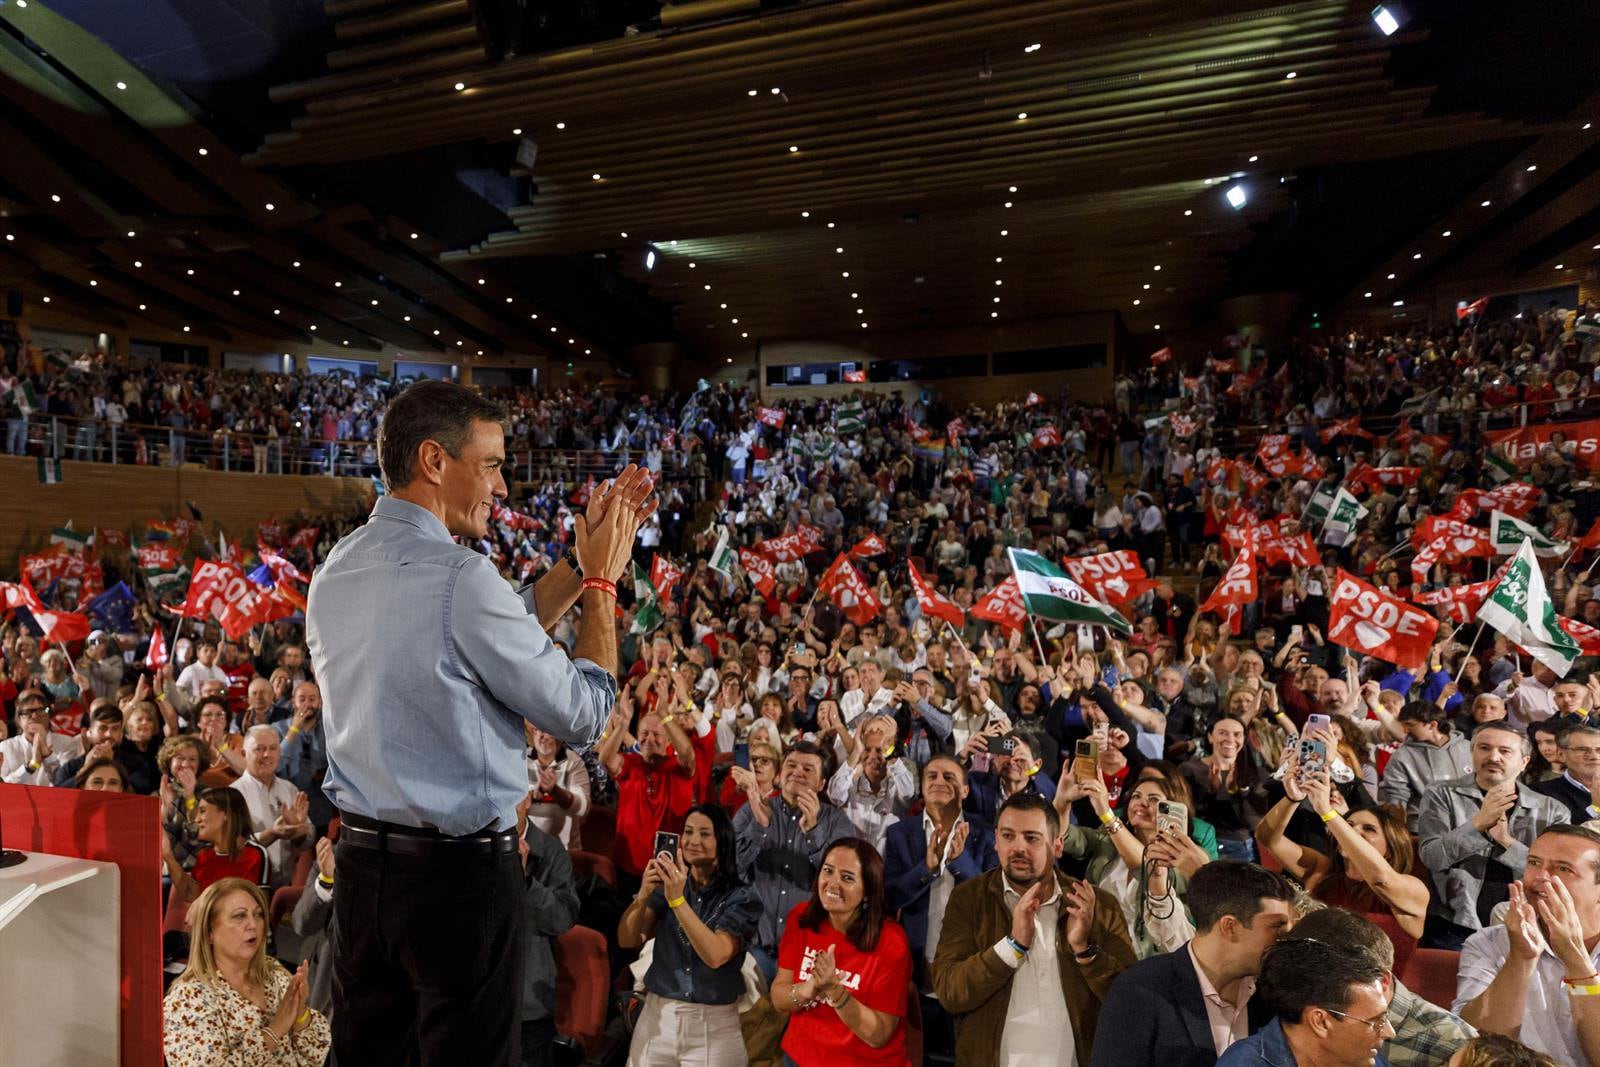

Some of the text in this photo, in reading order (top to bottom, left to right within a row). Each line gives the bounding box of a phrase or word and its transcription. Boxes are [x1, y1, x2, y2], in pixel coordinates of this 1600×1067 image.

[1499, 530, 1524, 540] PSO
[1067, 550, 1136, 584] PSOE
[193, 562, 258, 617] PSOE
[1332, 578, 1426, 637] PSOE
